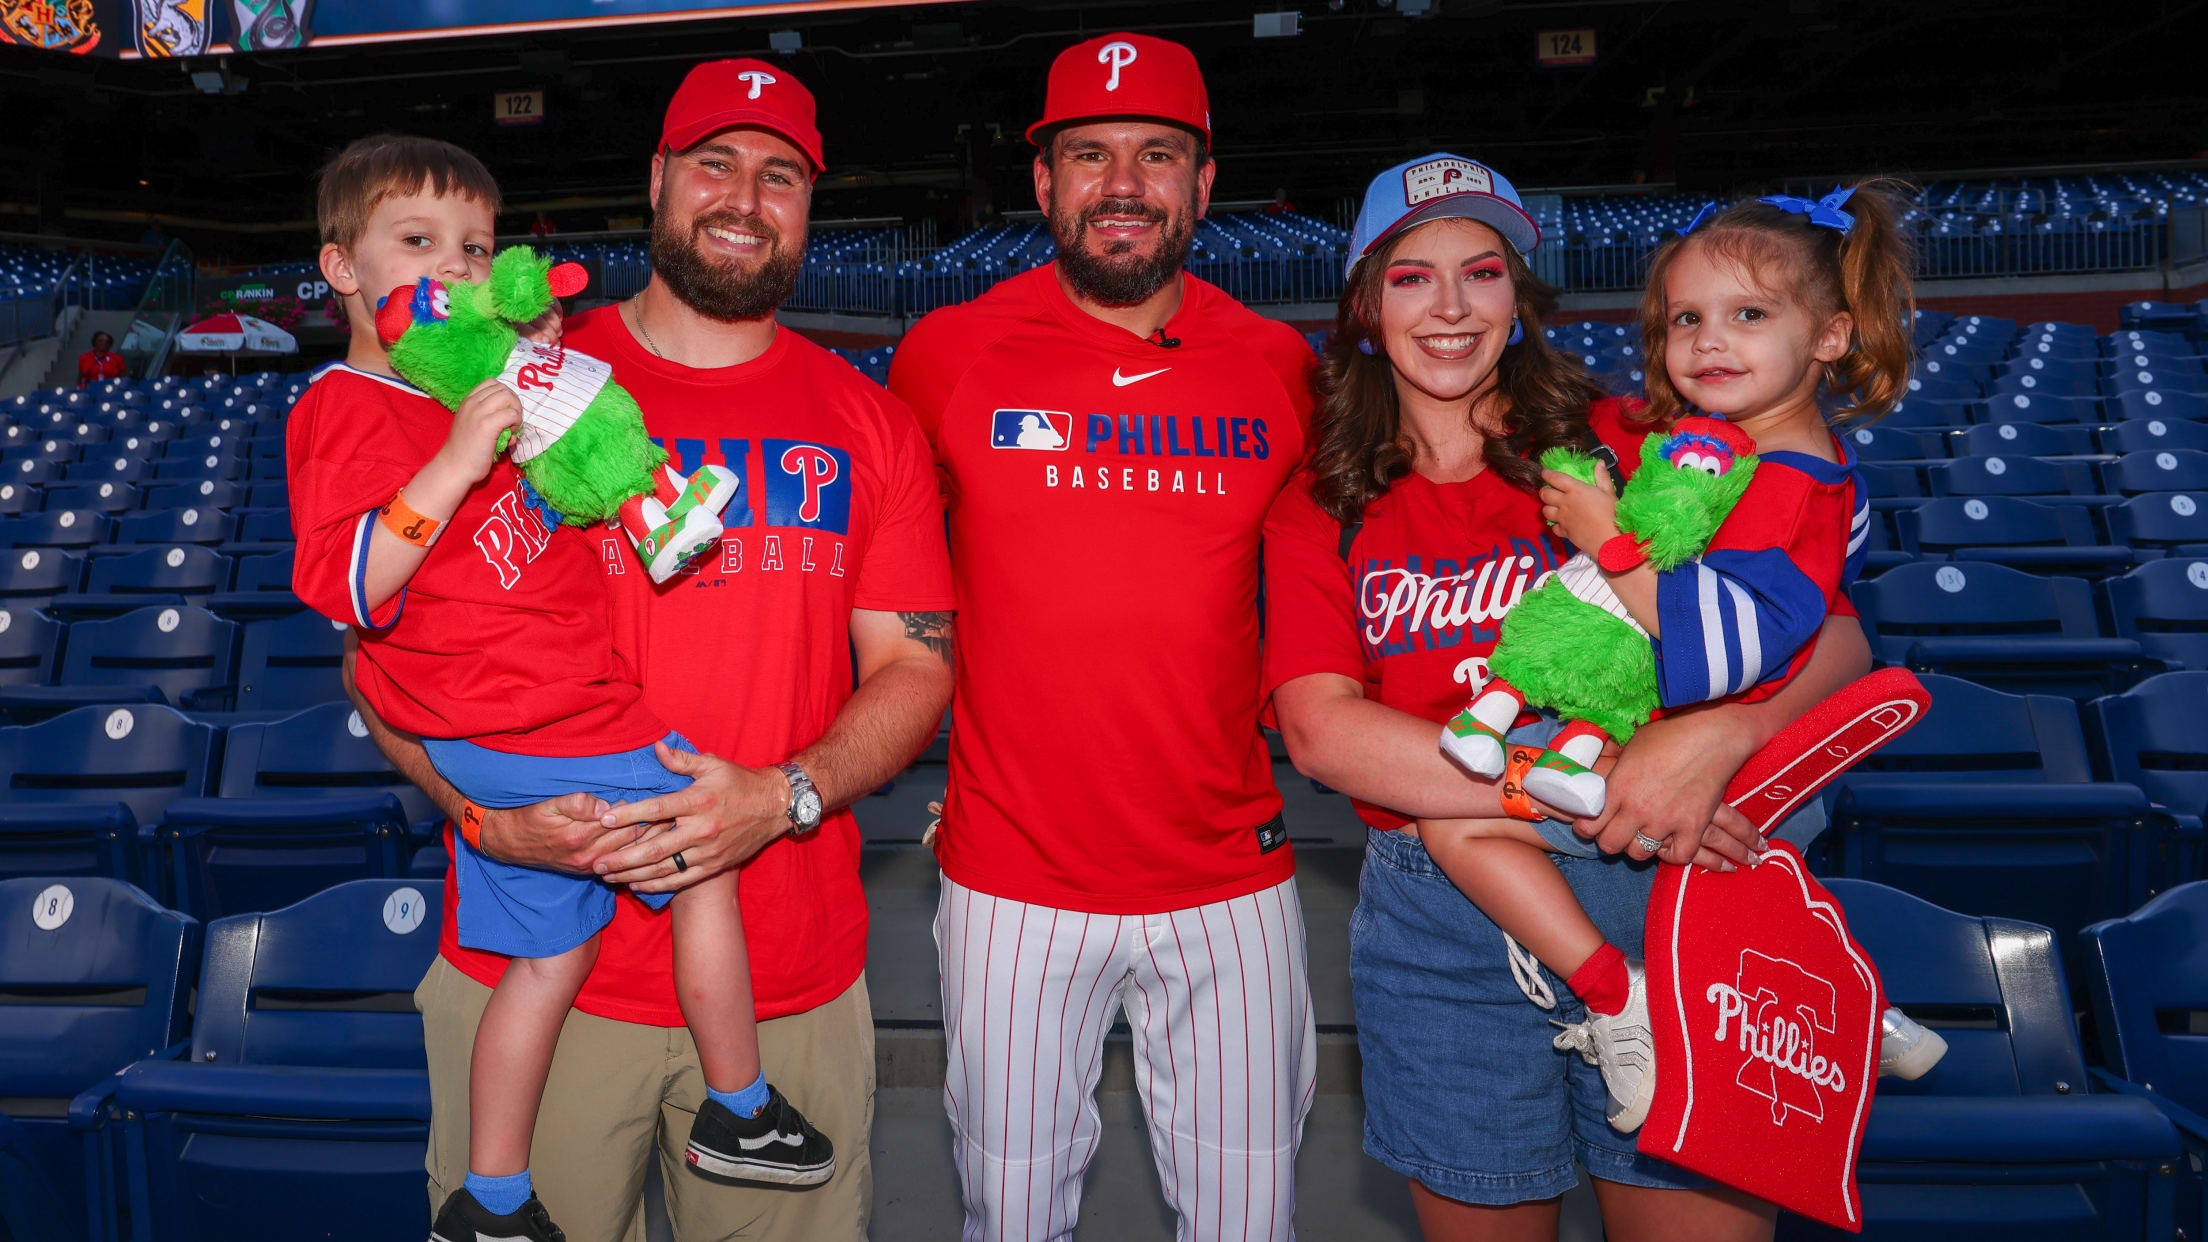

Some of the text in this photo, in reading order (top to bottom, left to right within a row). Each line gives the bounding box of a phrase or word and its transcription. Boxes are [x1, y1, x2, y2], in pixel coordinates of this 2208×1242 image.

[1552, 34, 1583, 55] 124
[1098, 41, 1138, 91] P
[737, 71, 777, 100] P
[505, 95, 532, 116] 122
[1411, 161, 1486, 176] PHILADELPHIA
[1086, 413, 1270, 461] PHILLIES
[781, 445, 839, 523] P
[1046, 465, 1227, 496] BASEBALL
[1361, 555, 1558, 645] Philli
[116, 719, 123, 730] 8
[48, 897, 58, 917] 8
[401, 902, 409, 919] 9
[1706, 982, 1846, 1093] Phillies
